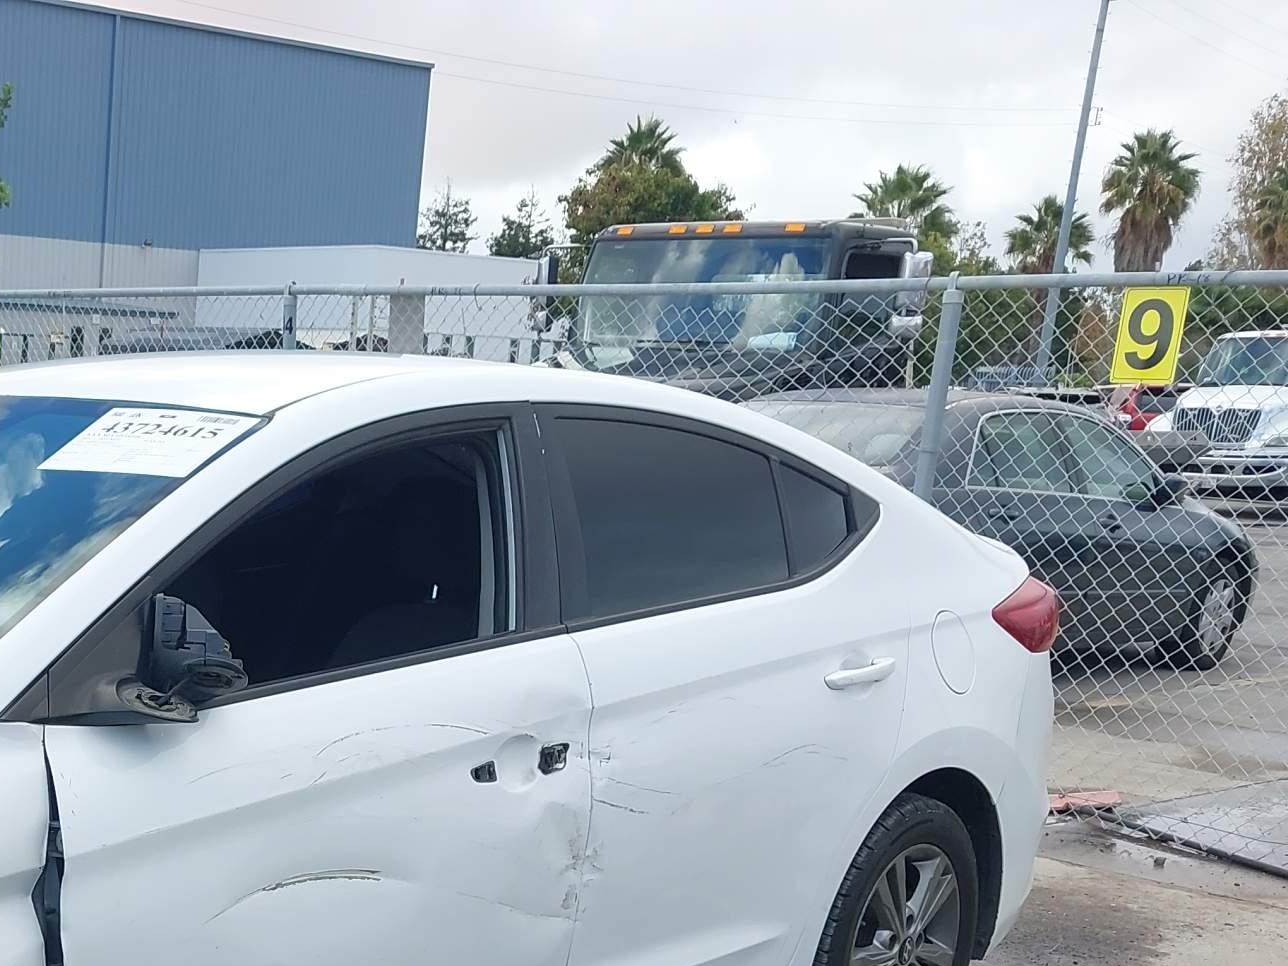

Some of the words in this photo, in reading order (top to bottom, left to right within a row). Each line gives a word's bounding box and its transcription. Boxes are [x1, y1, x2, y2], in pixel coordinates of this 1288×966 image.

[285, 316, 293, 336] 4
[1124, 298, 1175, 370] 9
[102, 421, 225, 439] 43724615
